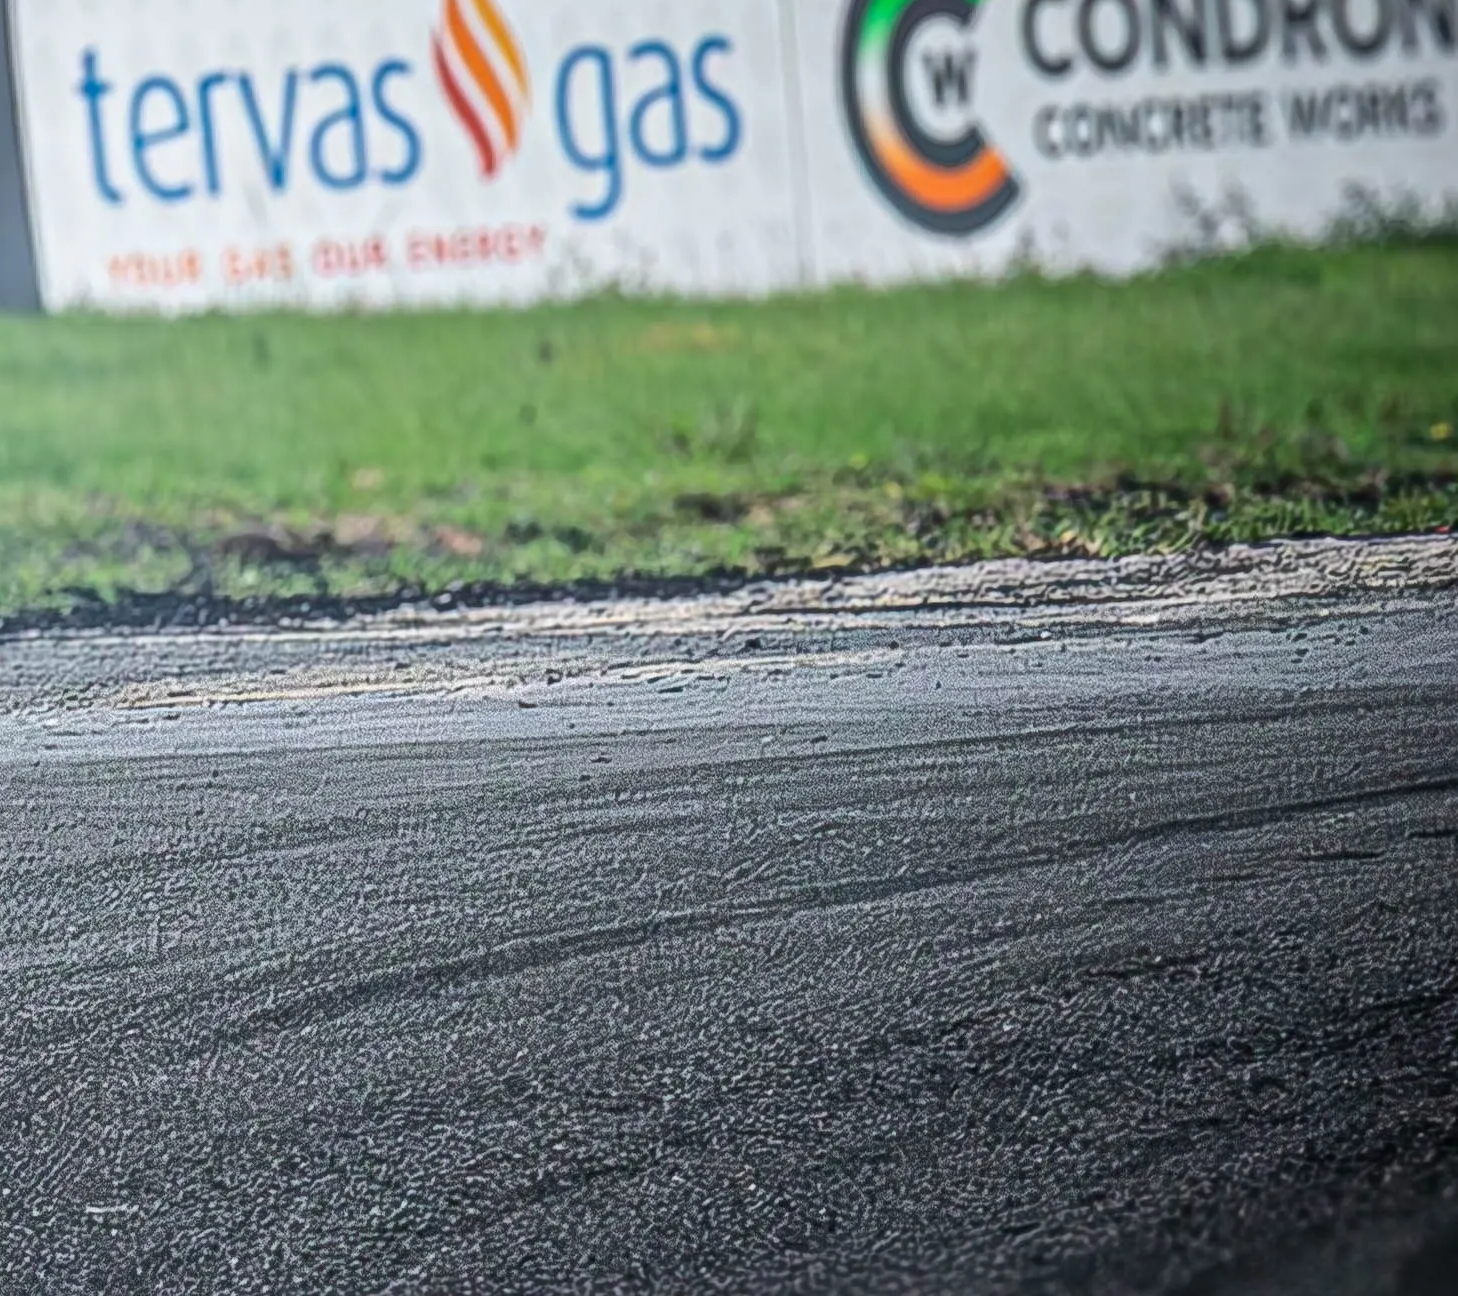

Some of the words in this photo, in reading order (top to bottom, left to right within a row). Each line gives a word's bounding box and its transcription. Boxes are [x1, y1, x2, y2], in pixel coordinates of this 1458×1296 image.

[78, 47, 423, 205] tervas
[555, 34, 741, 219] gas
[1034, 91, 1269, 158] CONCRETE
[1288, 77, 1444, 138] WORKS
